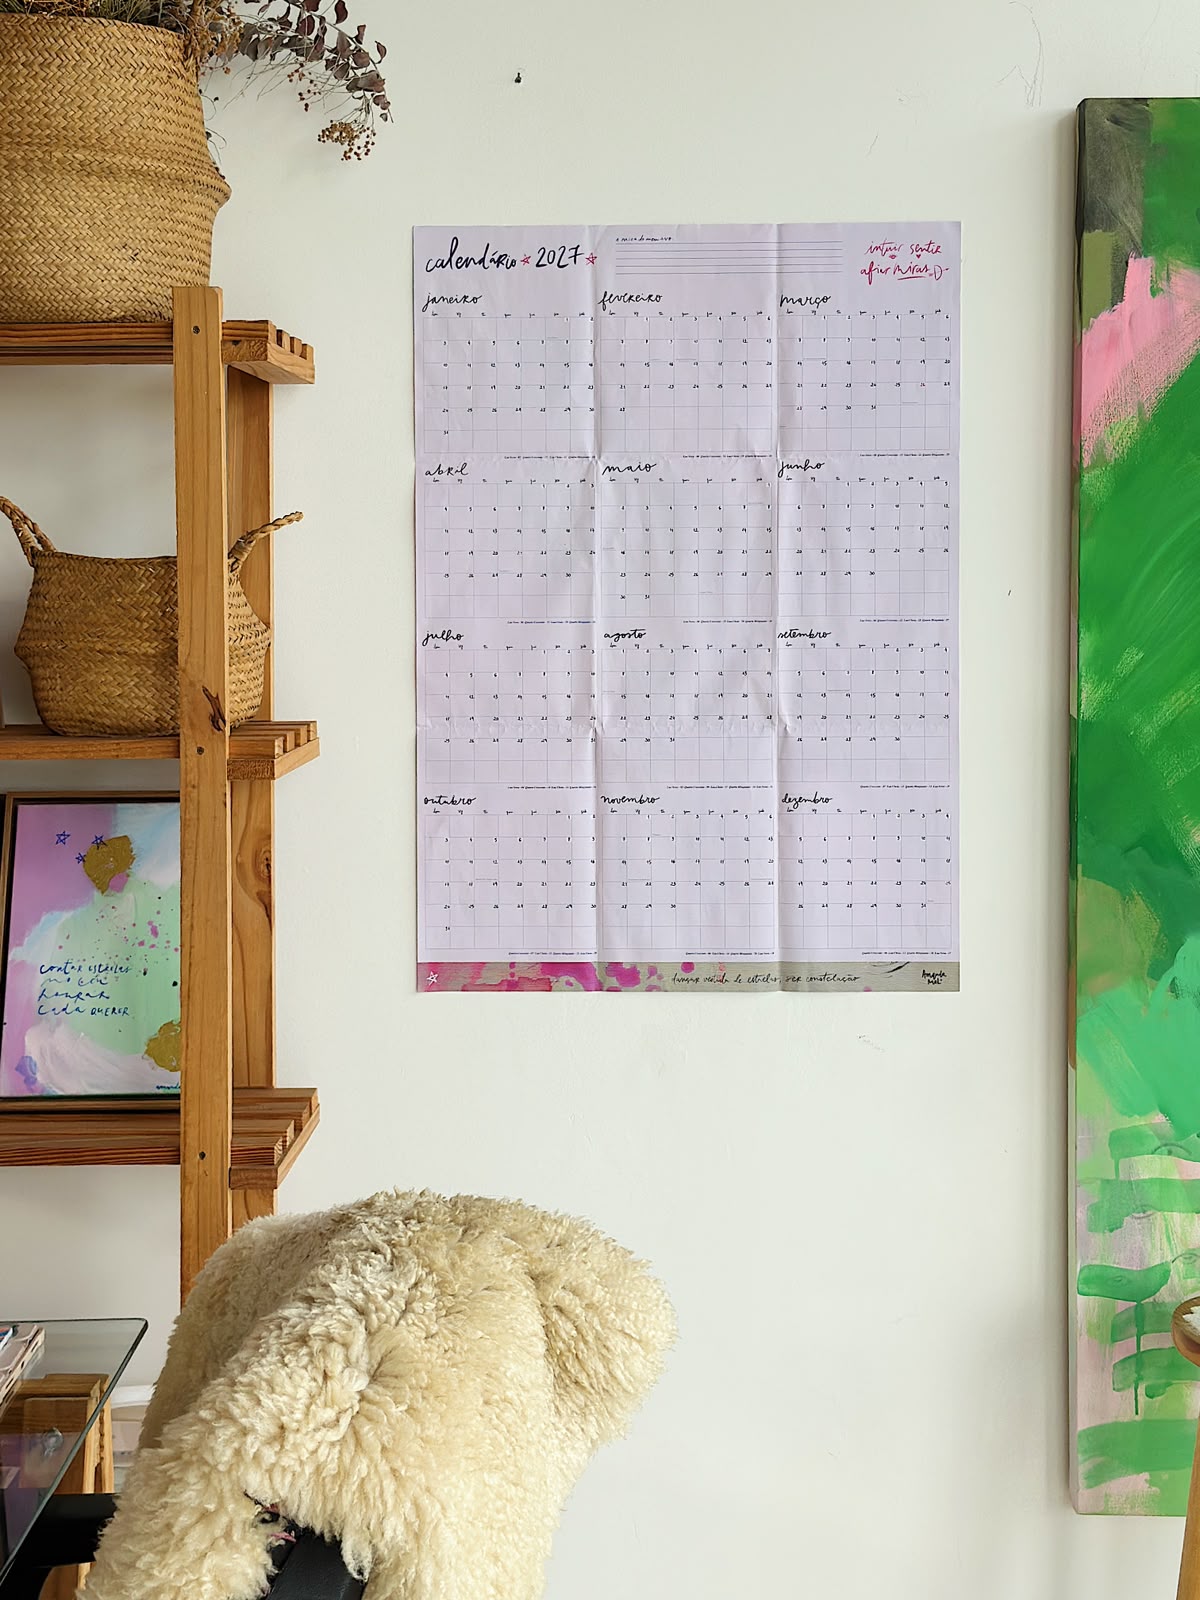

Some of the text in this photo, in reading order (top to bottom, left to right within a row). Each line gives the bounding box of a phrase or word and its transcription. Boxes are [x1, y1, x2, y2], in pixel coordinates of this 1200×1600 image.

[536, 244, 584, 268] 2027
[780, 294, 832, 308] março
[602, 462, 657, 475] maio
[778, 459, 825, 478] junho
[422, 630, 464, 646] julho
[604, 629, 646, 642] agosto
[777, 628, 831, 639] setembro
[424, 795, 476, 806] outubro
[601, 794, 660, 804] novembro
[781, 792, 832, 809] dezembro
